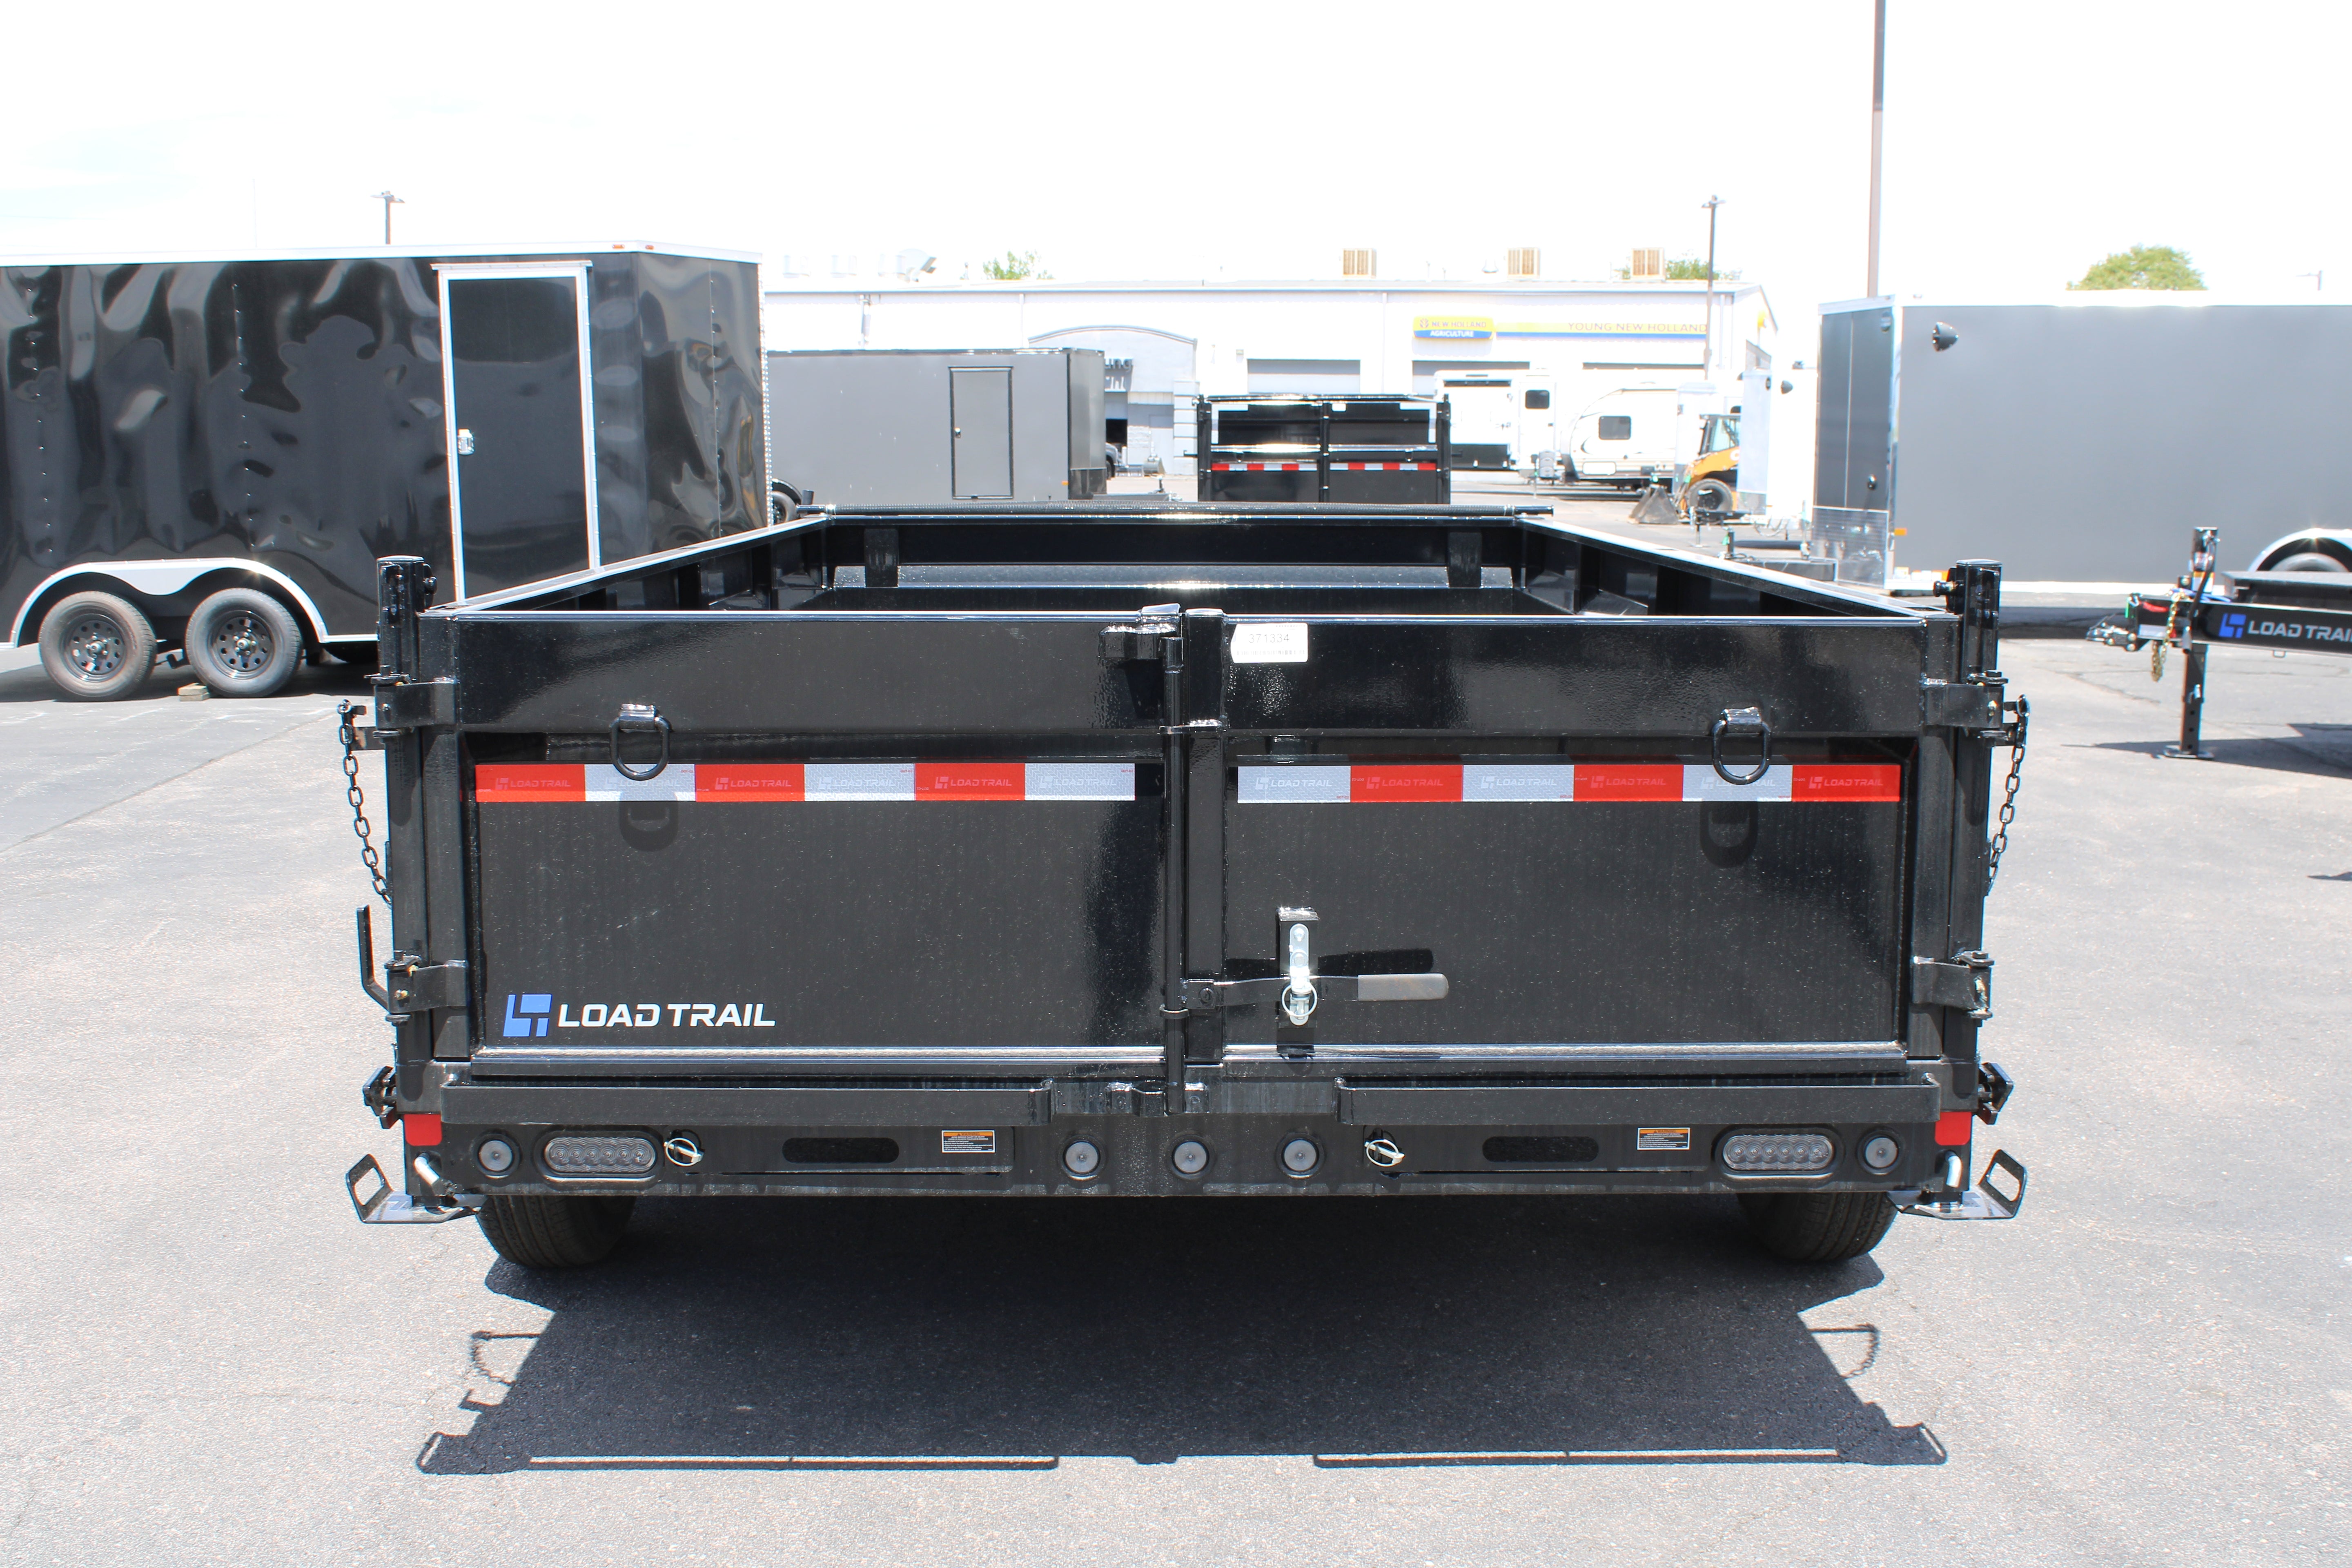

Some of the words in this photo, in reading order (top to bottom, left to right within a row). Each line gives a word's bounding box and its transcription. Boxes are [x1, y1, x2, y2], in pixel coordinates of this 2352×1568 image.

[1568, 323, 1612, 331] YOUNG
[1616, 323, 1644, 331] NEW
[1648, 323, 1707, 332] HOLLAND
[1249, 633, 1290, 644] 371334
[2248, 620, 2302, 638] LOAD
[2305, 625, 2352, 643] TRAI
[557, 1003, 661, 1027] LOAD
[667, 1003, 776, 1027] TRAIL
